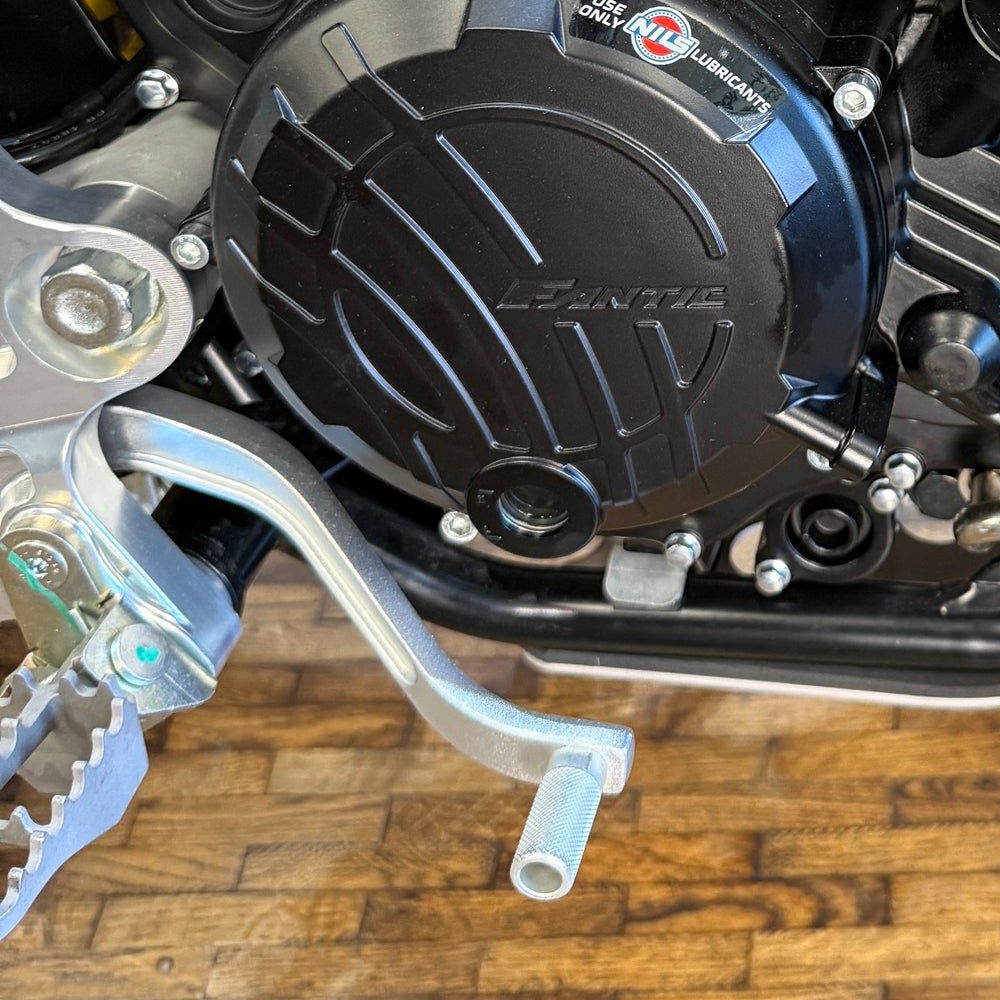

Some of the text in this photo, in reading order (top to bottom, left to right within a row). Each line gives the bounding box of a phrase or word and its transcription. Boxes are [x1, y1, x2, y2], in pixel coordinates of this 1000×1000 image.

[578, 5, 626, 30] ONLY
[628, 16, 697, 53] NILS
[690, 48, 772, 114] LUBRICANTS
